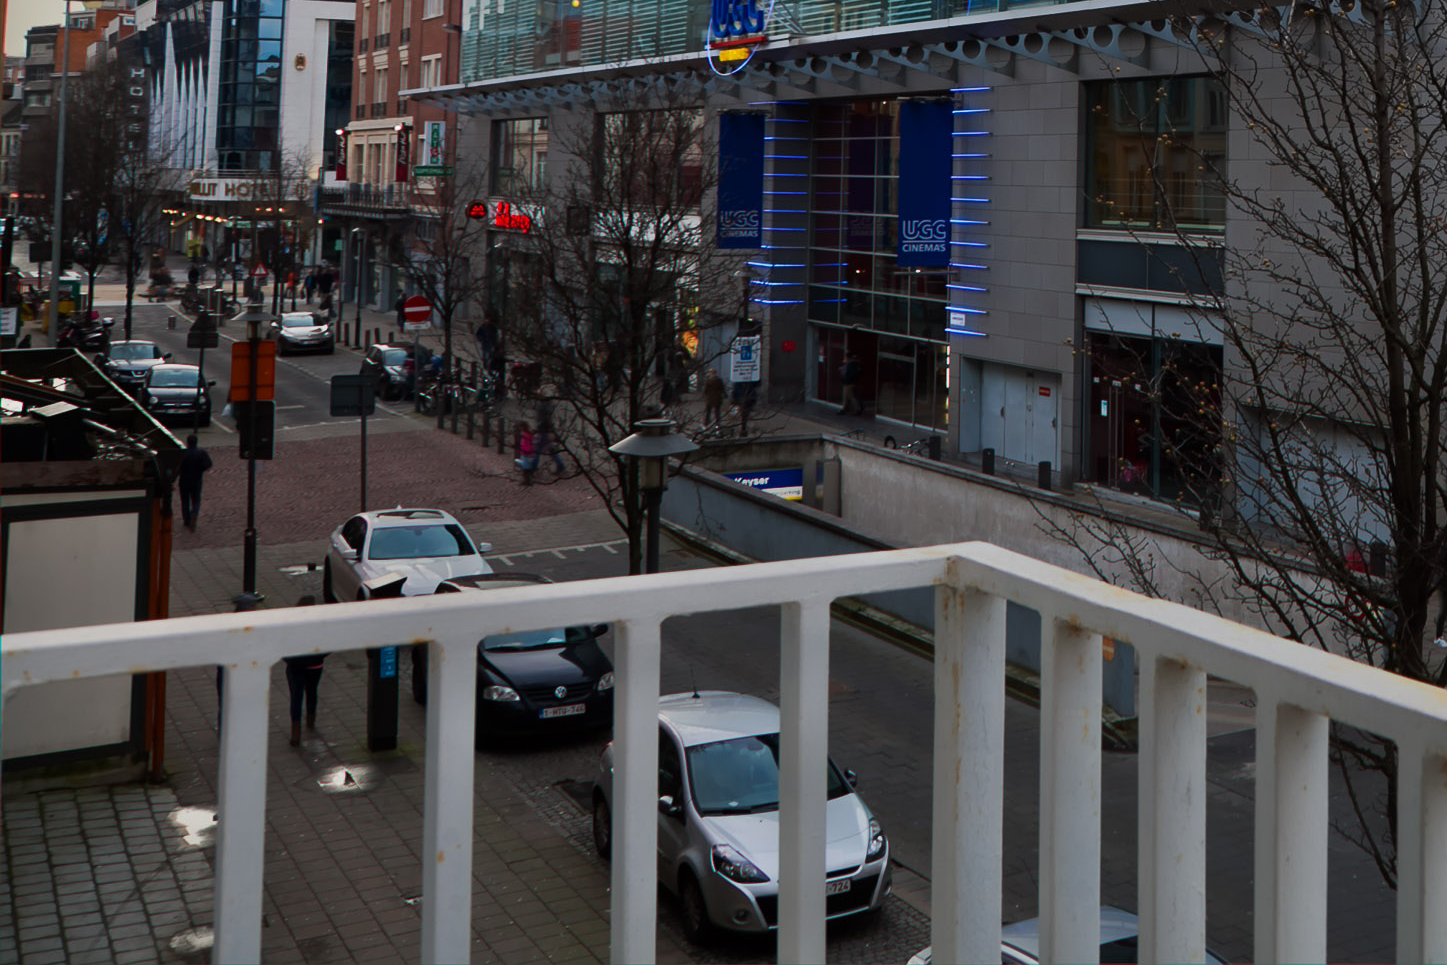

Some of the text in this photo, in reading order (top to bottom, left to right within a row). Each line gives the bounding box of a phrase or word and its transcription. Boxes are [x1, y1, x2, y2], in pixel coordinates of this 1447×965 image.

[720, 210, 760, 228] UGC
[902, 219, 947, 240] UGC
[901, 243, 947, 253] CINEMAS
